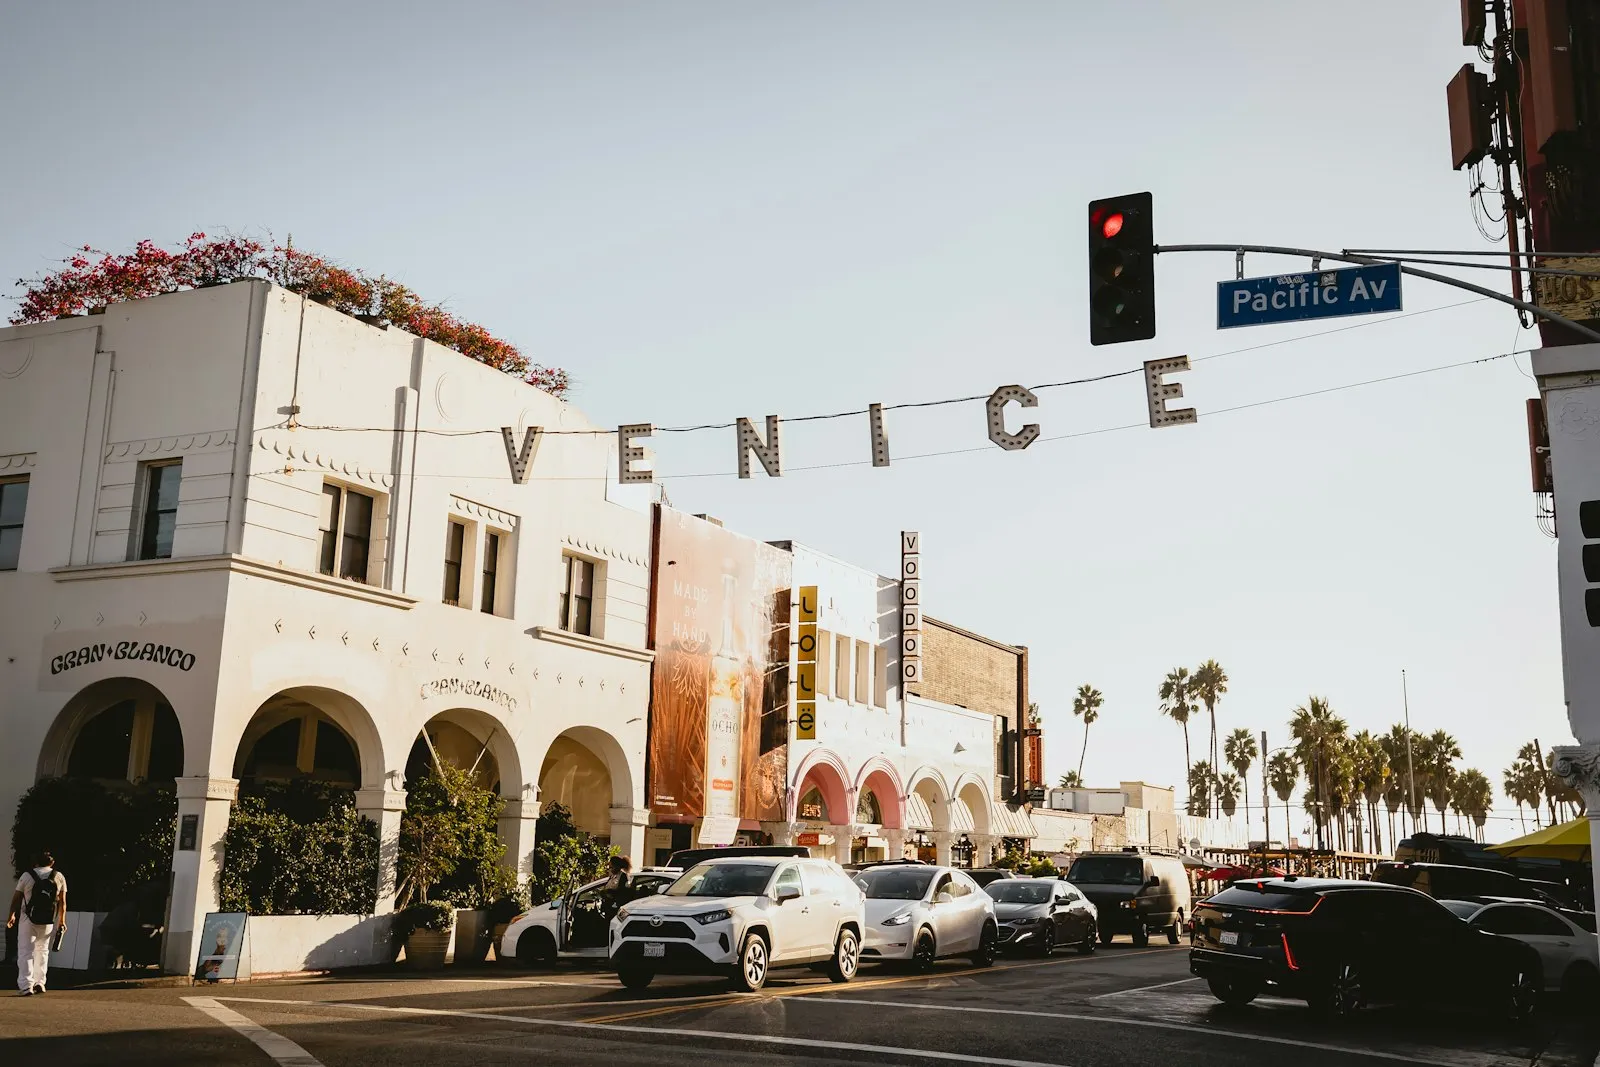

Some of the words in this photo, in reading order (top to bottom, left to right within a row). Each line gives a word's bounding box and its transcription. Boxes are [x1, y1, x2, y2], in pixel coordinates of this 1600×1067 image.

[1233, 281, 1338, 314] Pacific
[1349, 277, 1387, 302] Av
[501, 355, 1197, 485] VENICE
[673, 579, 709, 603] MADE
[684, 605, 697, 618] BY
[905, 536, 917, 678] VOODOO
[672, 620, 706, 643] HAND
[51, 643, 106, 675] GRAN
[114, 641, 196, 671] BLANCO
[712, 719, 738, 734] OCHO
